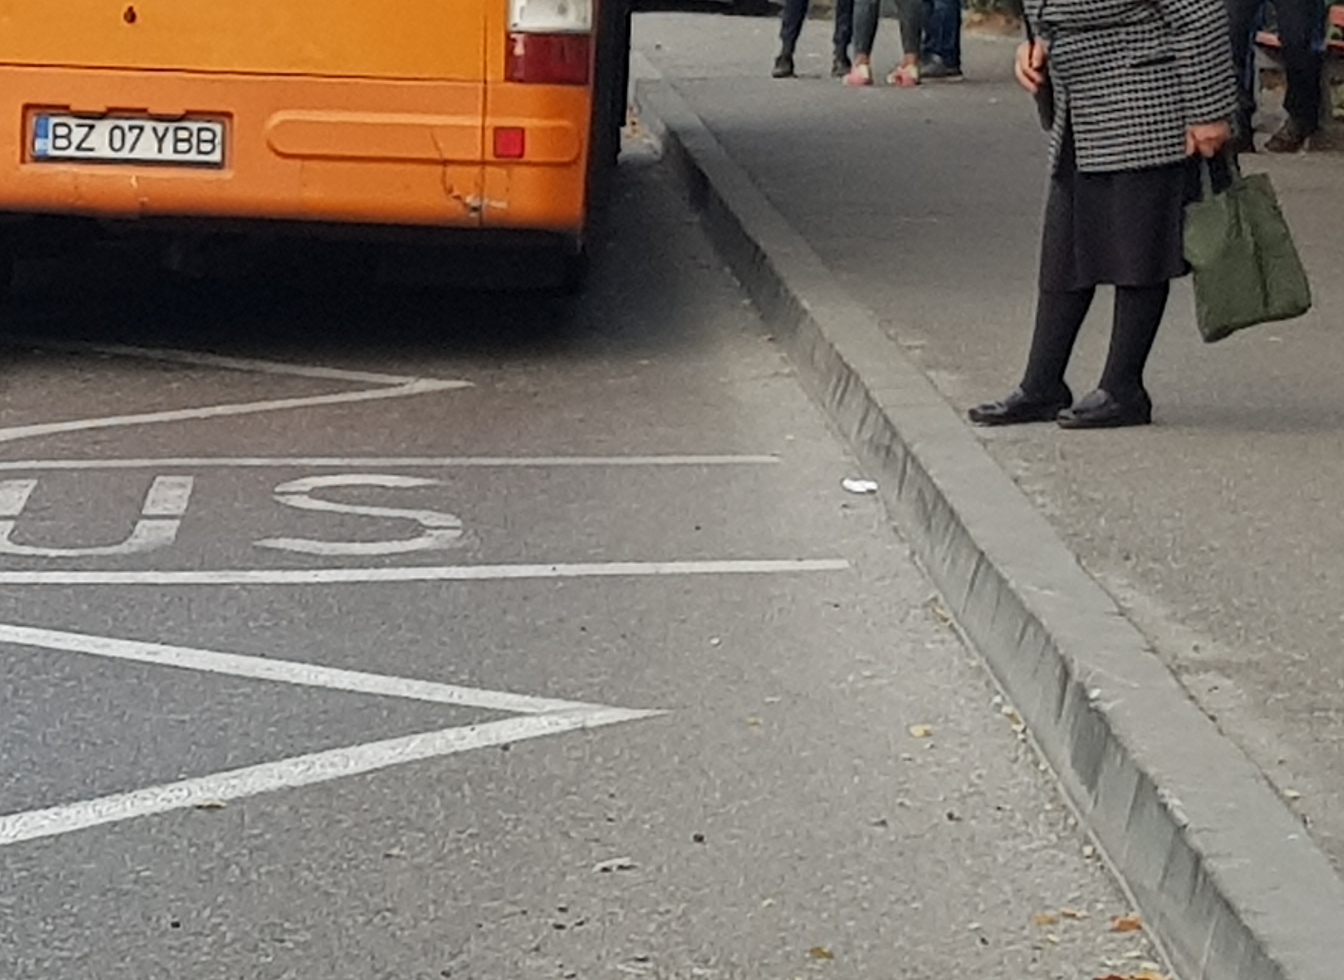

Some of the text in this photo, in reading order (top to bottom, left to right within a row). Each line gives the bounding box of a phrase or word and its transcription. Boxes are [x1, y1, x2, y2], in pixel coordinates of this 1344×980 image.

[51, 122, 218, 156] BZ 07 YBB
